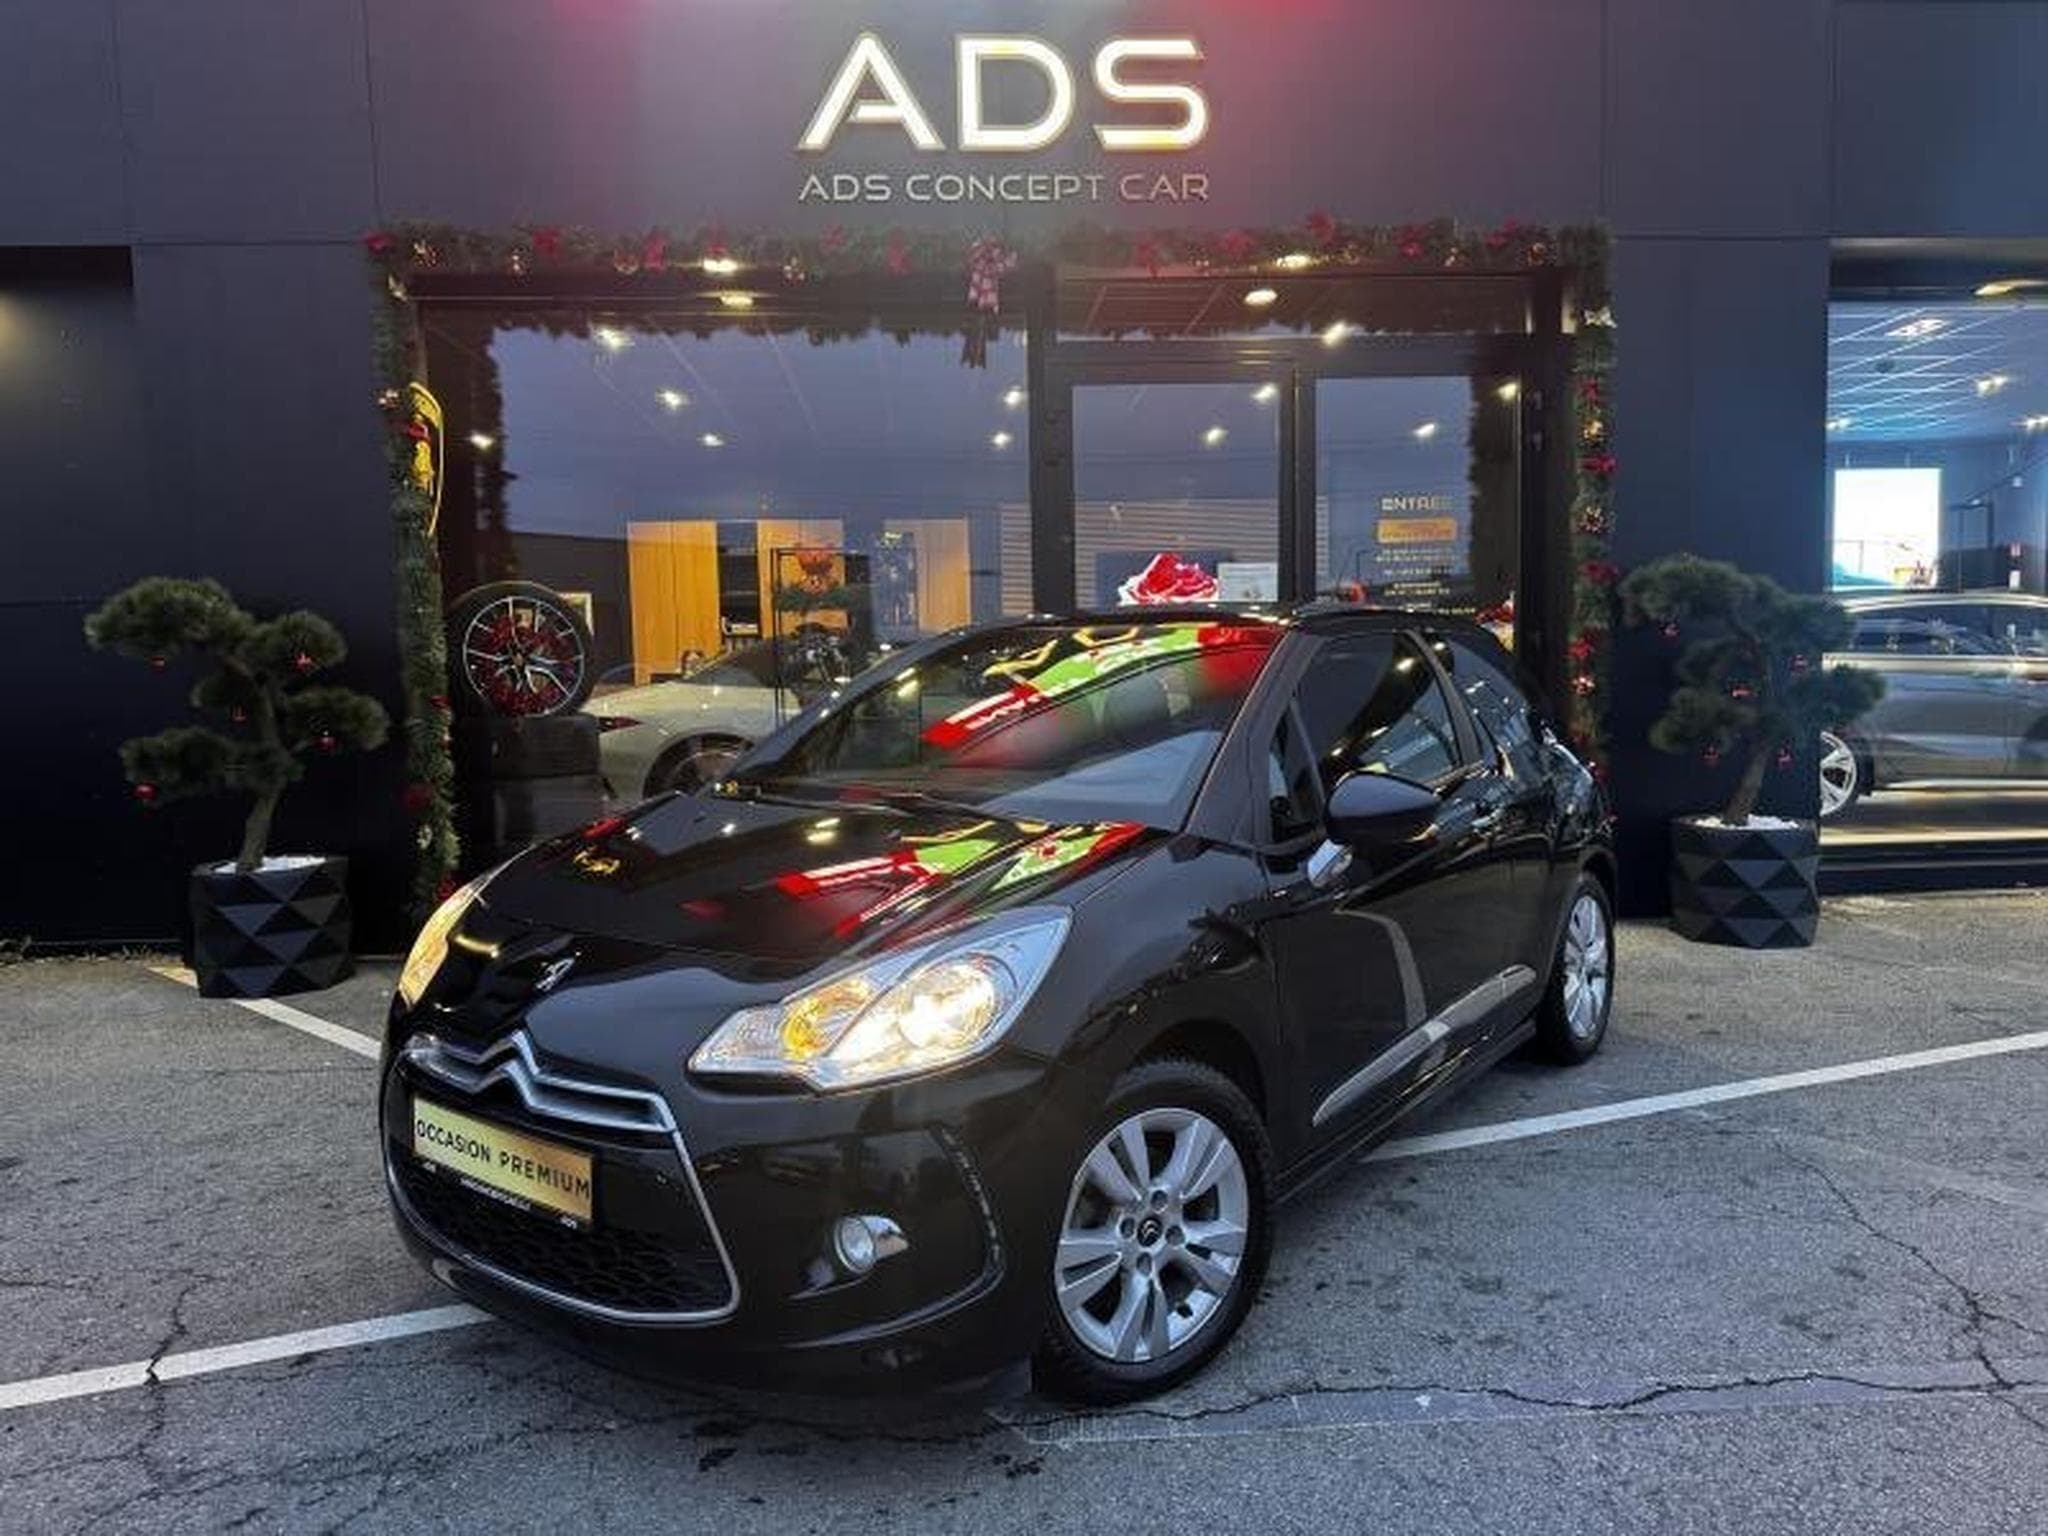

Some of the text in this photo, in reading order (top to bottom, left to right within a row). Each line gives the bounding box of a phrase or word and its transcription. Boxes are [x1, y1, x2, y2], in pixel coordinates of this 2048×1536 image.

[797, 32, 1209, 151] ADS
[799, 174, 1209, 201] ADS CONCEPT CAR
[416, 1119, 491, 1163] OCCASION
[500, 1151, 590, 1199] PREMIUM
